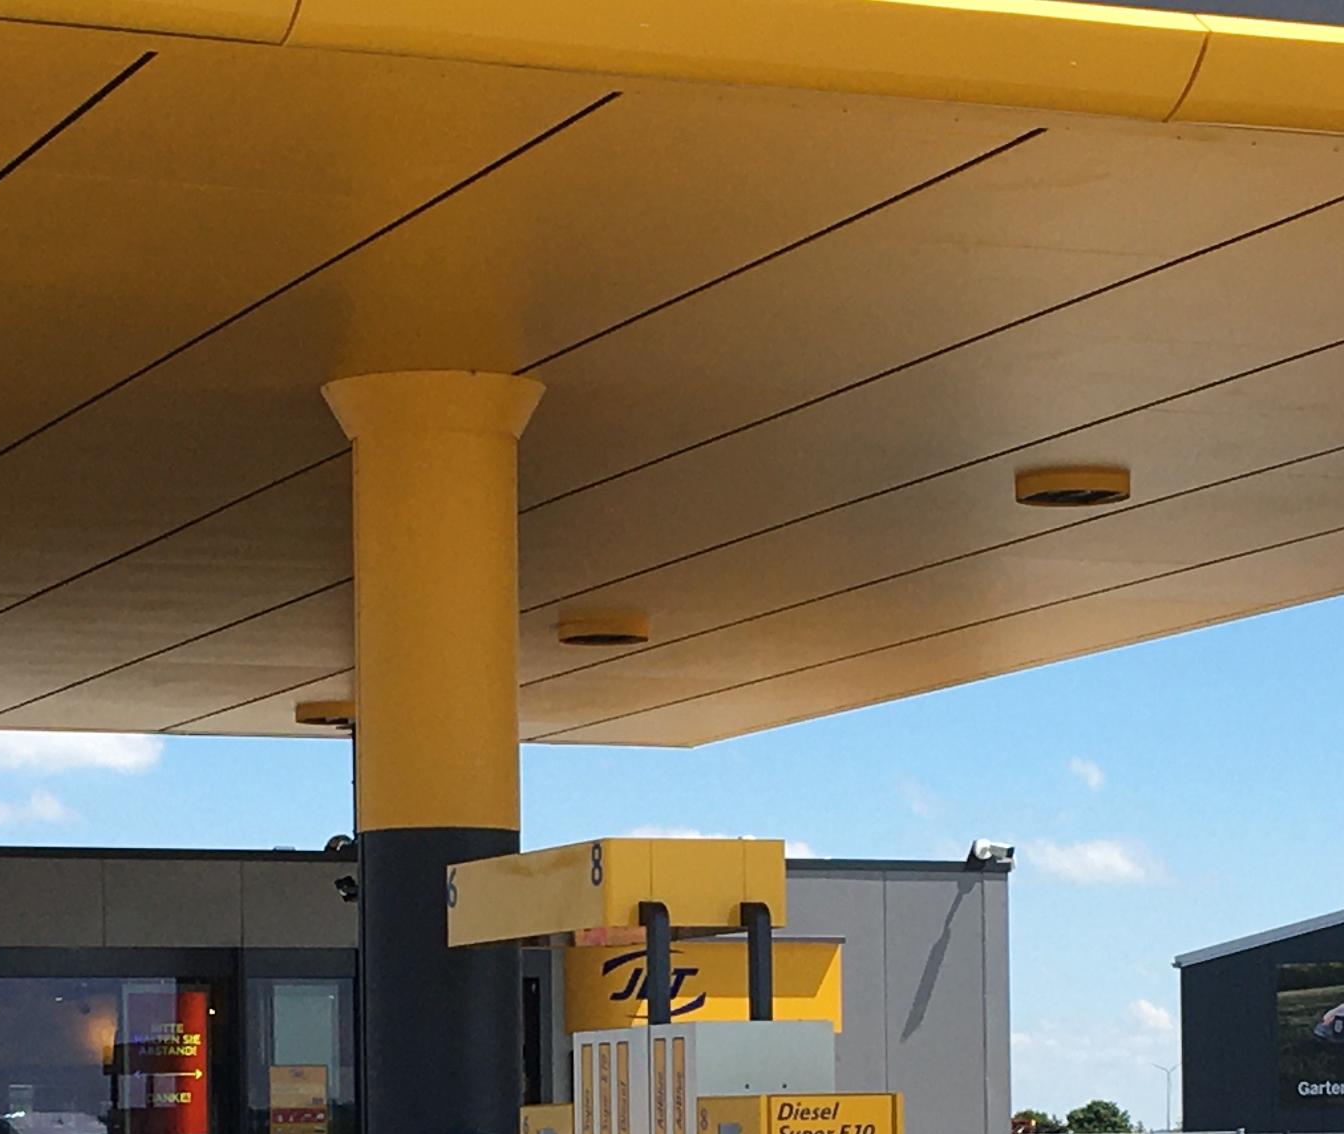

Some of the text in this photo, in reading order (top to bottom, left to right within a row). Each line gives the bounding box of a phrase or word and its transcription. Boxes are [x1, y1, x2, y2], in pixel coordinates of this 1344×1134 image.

[591, 843, 603, 886] 8
[447, 867, 458, 908] 6
[777, 1101, 840, 1121] Diesel
